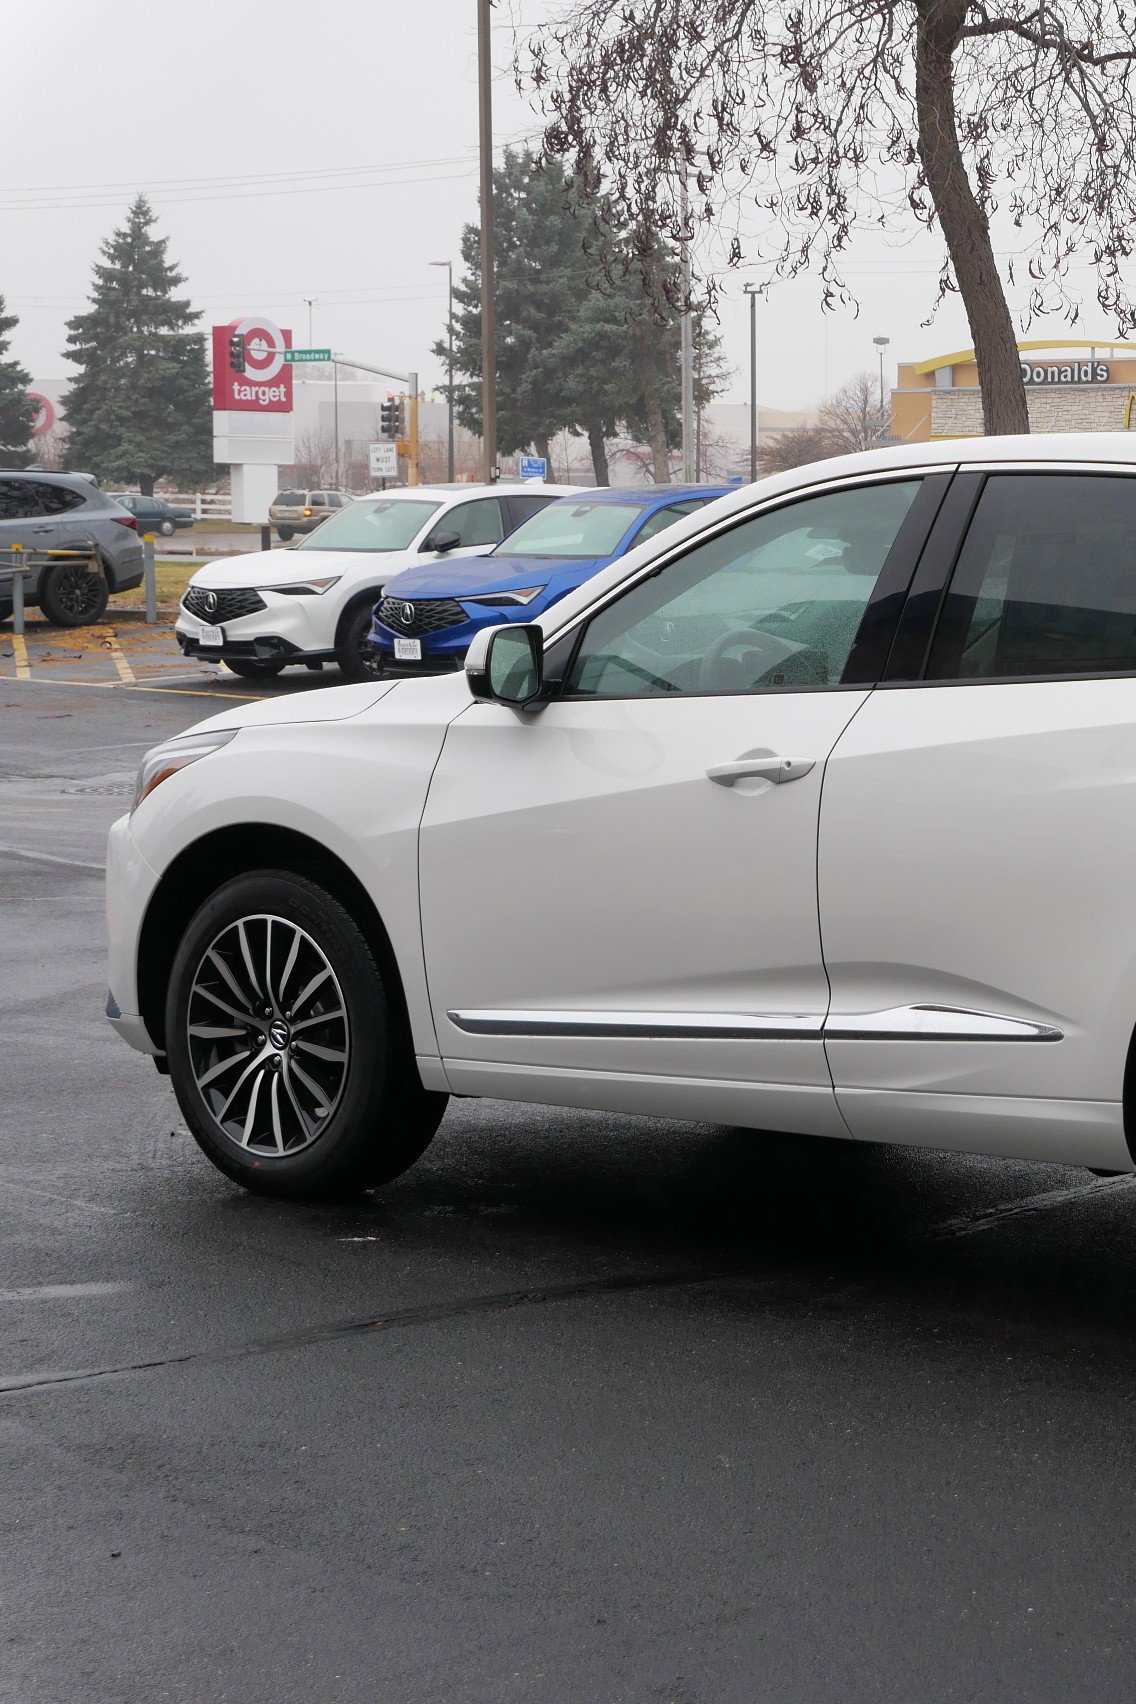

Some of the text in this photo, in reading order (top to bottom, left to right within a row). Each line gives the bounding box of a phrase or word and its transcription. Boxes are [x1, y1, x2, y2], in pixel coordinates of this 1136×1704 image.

[285, 352, 329, 361] W Broadway
[1020, 361, 1109, 383] Donald's
[232, 381, 287, 405] target
